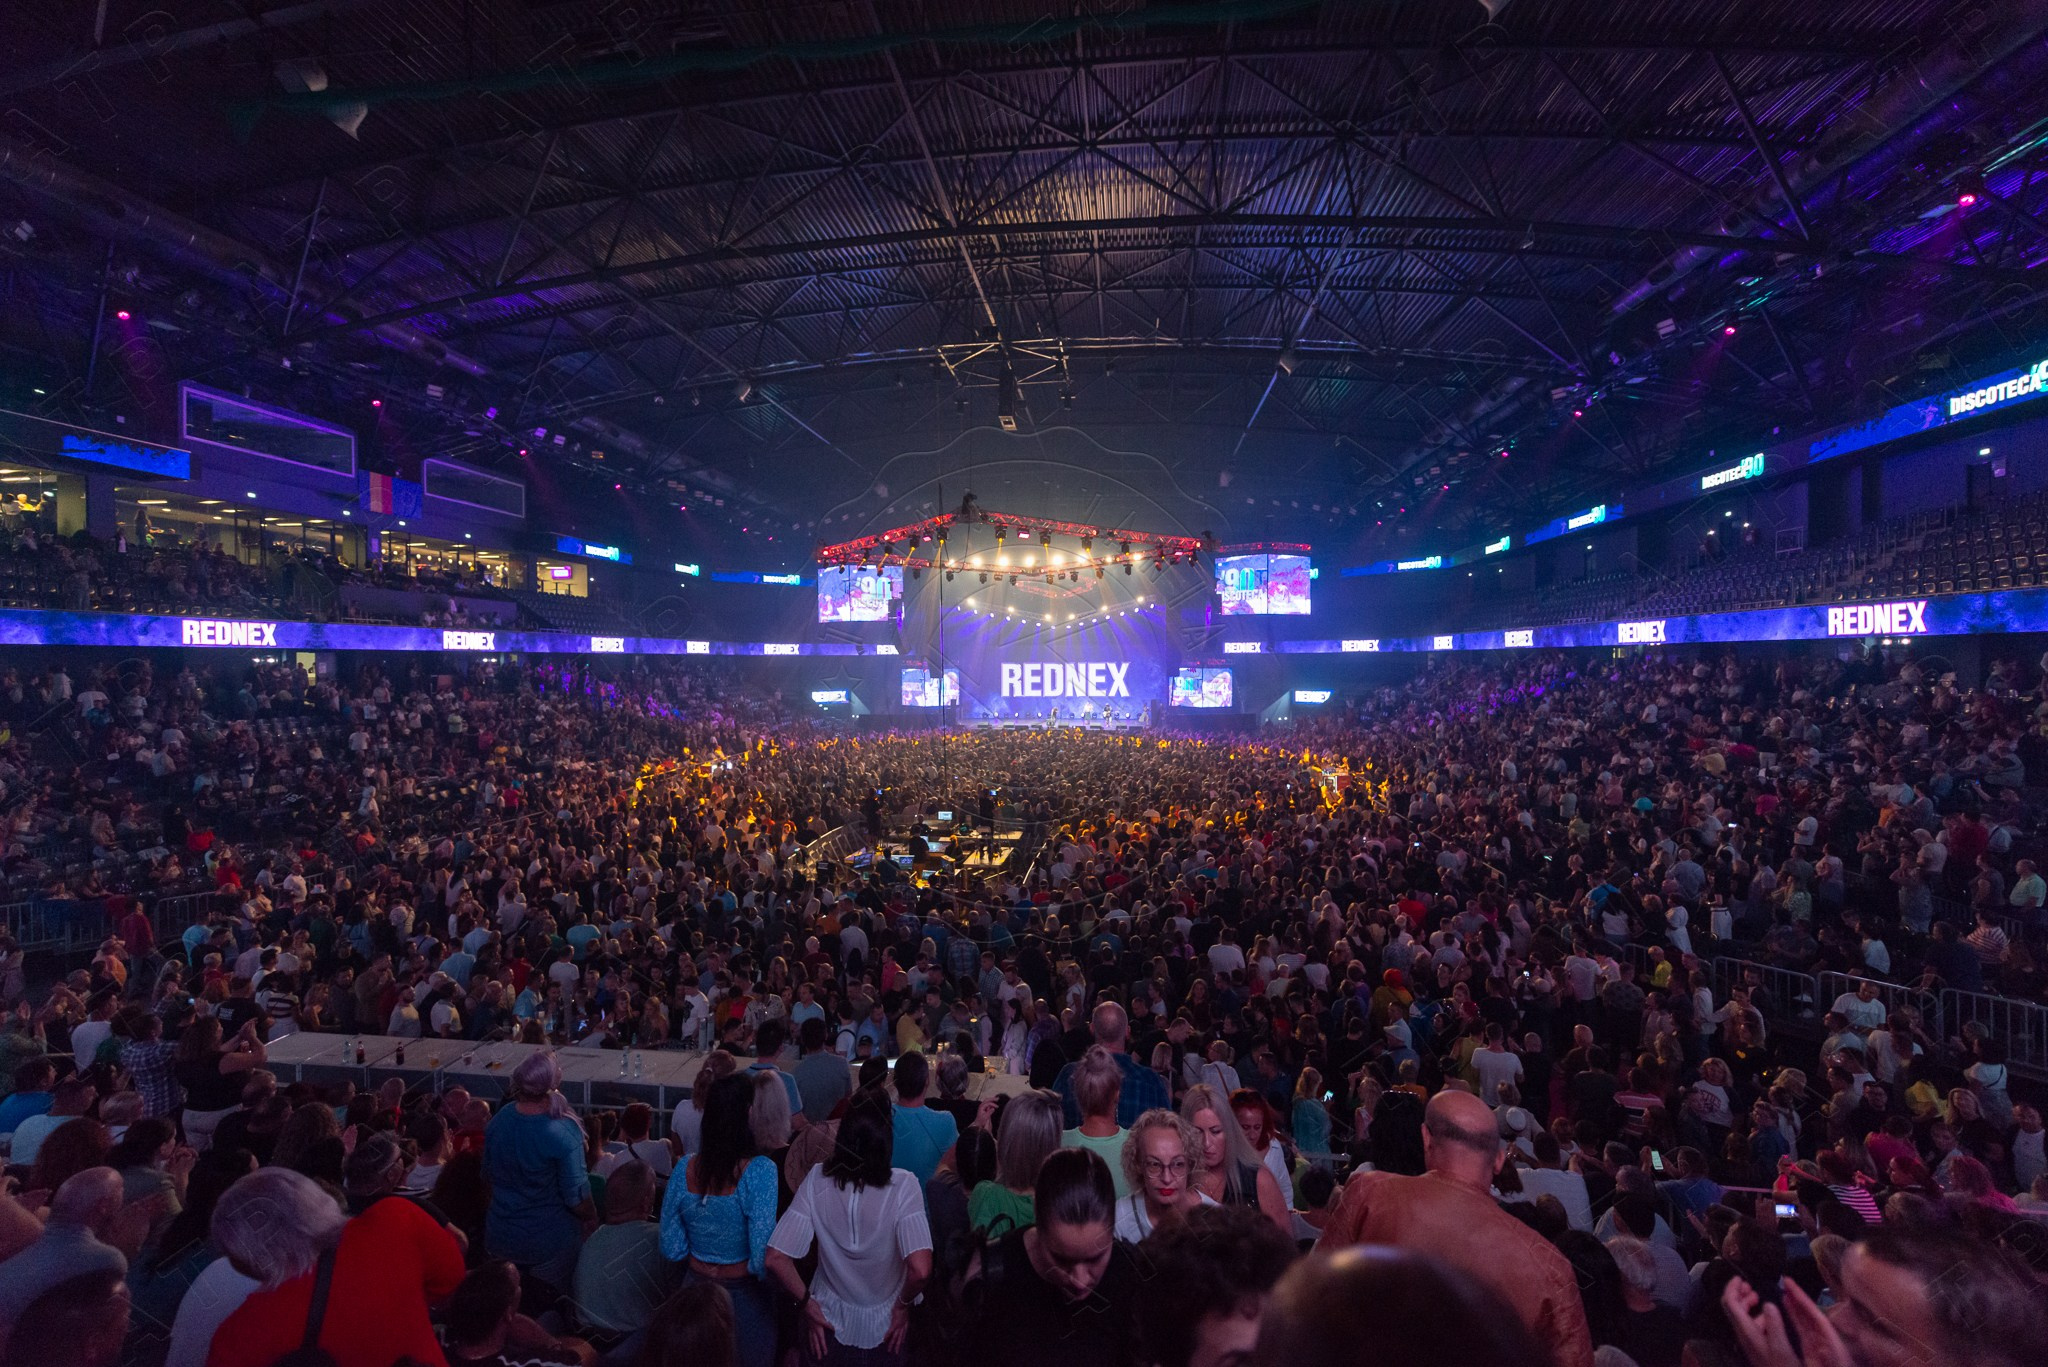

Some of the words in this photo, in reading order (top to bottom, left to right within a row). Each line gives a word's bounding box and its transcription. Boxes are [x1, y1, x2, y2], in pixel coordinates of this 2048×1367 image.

[1950, 374, 2041, 416] DISCOTECA
[1221, 590, 1263, 601] ISCOTECA
[1828, 601, 1927, 636] REDNEX
[182, 619, 276, 646] REDNEX
[443, 630, 495, 650] REDNEX
[1618, 620, 1666, 643] REDNEX
[1224, 642, 1261, 653] REDNEX
[1342, 640, 1379, 651] REDNEX
[1001, 662, 1130, 698] REDNEX
